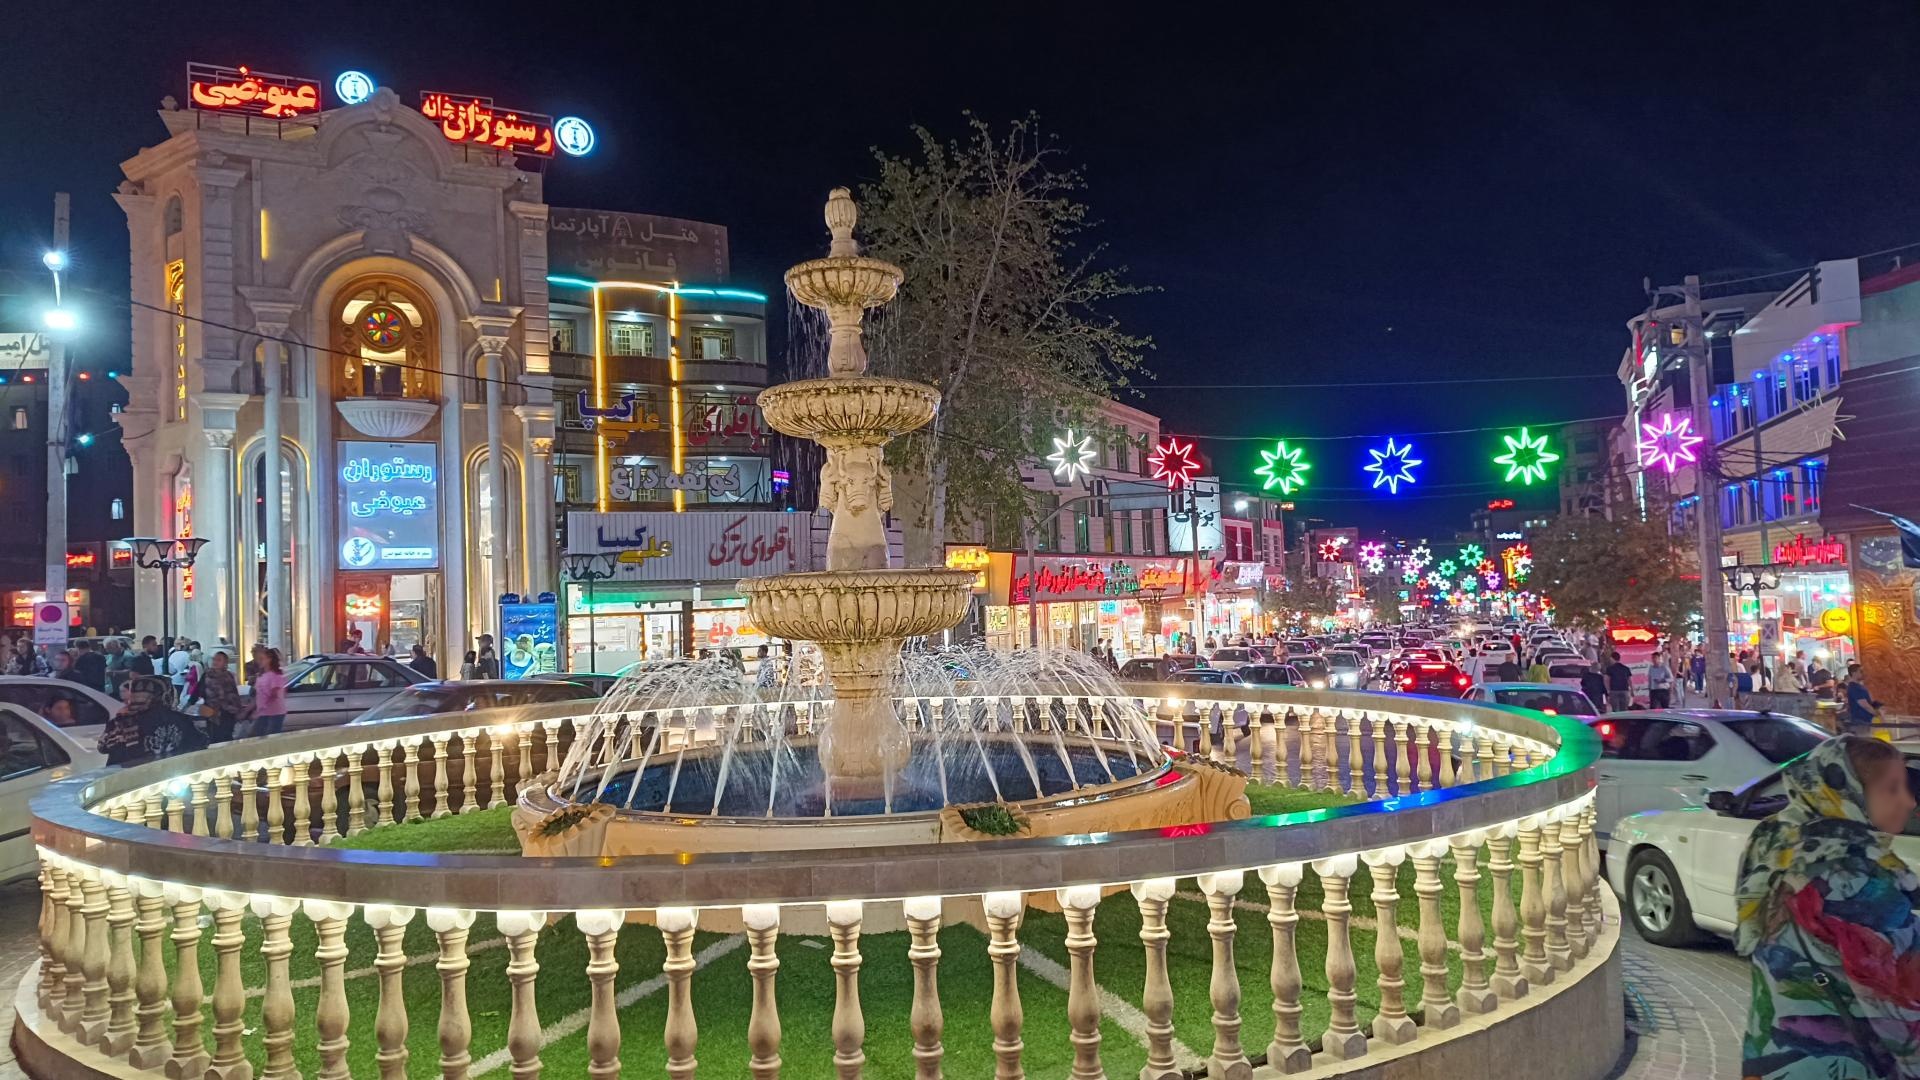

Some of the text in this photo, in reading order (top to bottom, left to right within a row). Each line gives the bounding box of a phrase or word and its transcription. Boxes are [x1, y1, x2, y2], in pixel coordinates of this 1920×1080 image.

[193, 66, 317, 118] عیوضی
[443, 103, 553, 152] رستوران
[550, 215, 699, 243] هتل آپارتما
[575, 251, 678, 272] فانوس
[343, 456, 432, 482] رستوران
[610, 456, 660, 500] داغ
[351, 489, 426, 517] عیوضی
[709, 515, 797, 568] باقلوای ترکی
[707, 622, 733, 645] داغ
